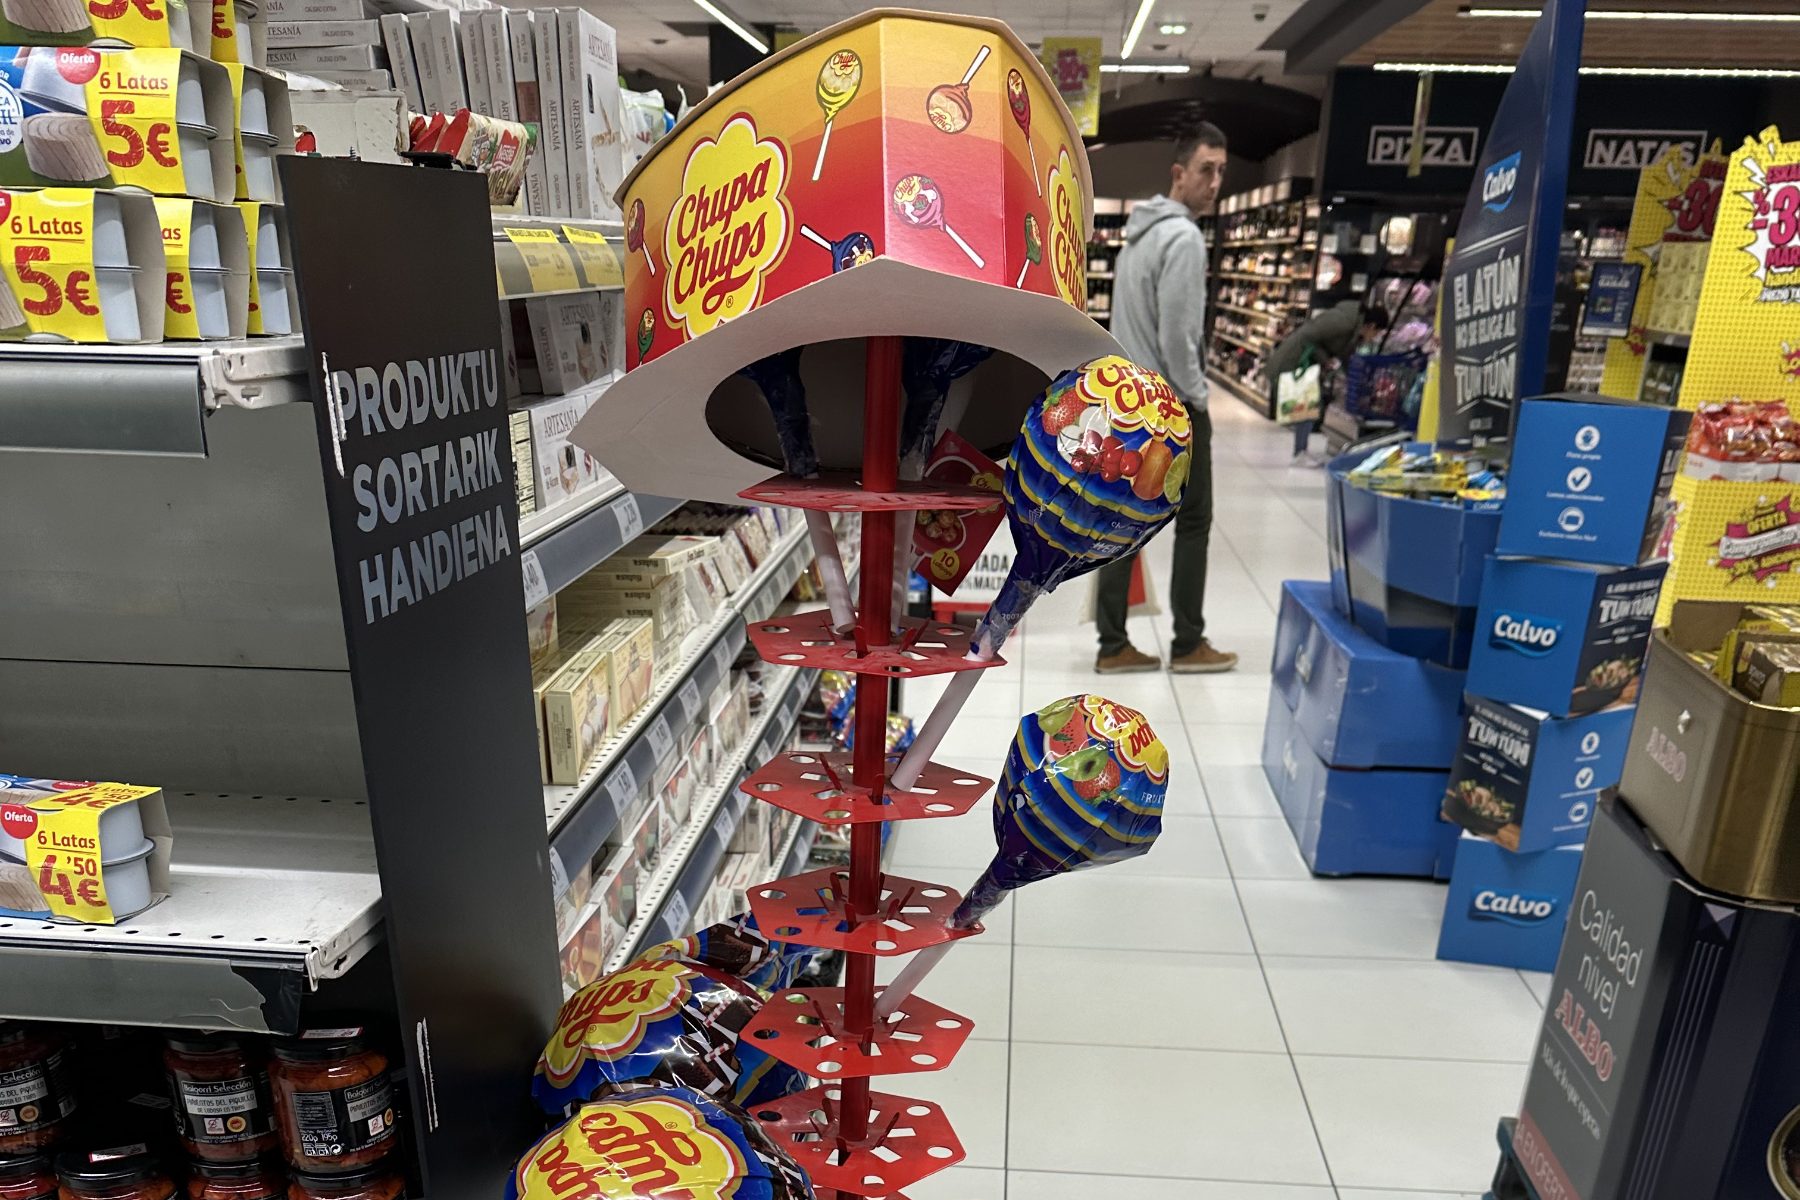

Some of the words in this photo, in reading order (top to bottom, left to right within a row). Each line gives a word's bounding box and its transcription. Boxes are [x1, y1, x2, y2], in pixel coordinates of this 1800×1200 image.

[61, 53, 95, 63] Oferta
[100, 72, 111, 89] 6
[117, 72, 169, 90] Latas
[101, 99, 178, 168] 5€
[548, 99, 560, 151] ARTESANÍA
[572, 98, 584, 150] ARTESANÍA
[677, 157, 772, 248] Chupa
[1483, 166, 1518, 201] Calvo
[11, 216, 22, 235] 6
[29, 217, 83, 235] Latas
[1056, 184, 1084, 269] Chup
[15, 245, 99, 316] 5€
[674, 212, 769, 315] Chups
[1055, 231, 1085, 312] Chup
[1454, 273, 1471, 321] EL
[1473, 247, 1521, 315] ATÚN
[330, 349, 498, 440] PRODUKTU
[543, 405, 579, 439] ARTESANÍA
[353, 428, 503, 532] SORTARIK
[359, 505, 512, 625] HANDIENA
[938, 550, 956, 568] 10
[1494, 613, 1557, 646] Calvo
[102, 786, 147, 794] Latas
[4, 811, 33, 823] Oferta
[37, 830, 47, 845] 6
[52, 832, 96, 849] Latas
[39, 855, 107, 907] 4€
[1475, 891, 1552, 918] Calvo
[1579, 889, 1643, 989] Calidad
[1577, 952, 1620, 1020] nivel
[1554, 988, 1615, 1082] ALBO
[3, 1068, 41, 1084] Selección
[183, 1083, 212, 1095] Baigorri
[213, 1080, 252, 1093] Selección
[302, 1133, 318, 1143] 220g
[321, 1133, 338, 1143] 195g
[1523, 1131, 1538, 1165] EN
